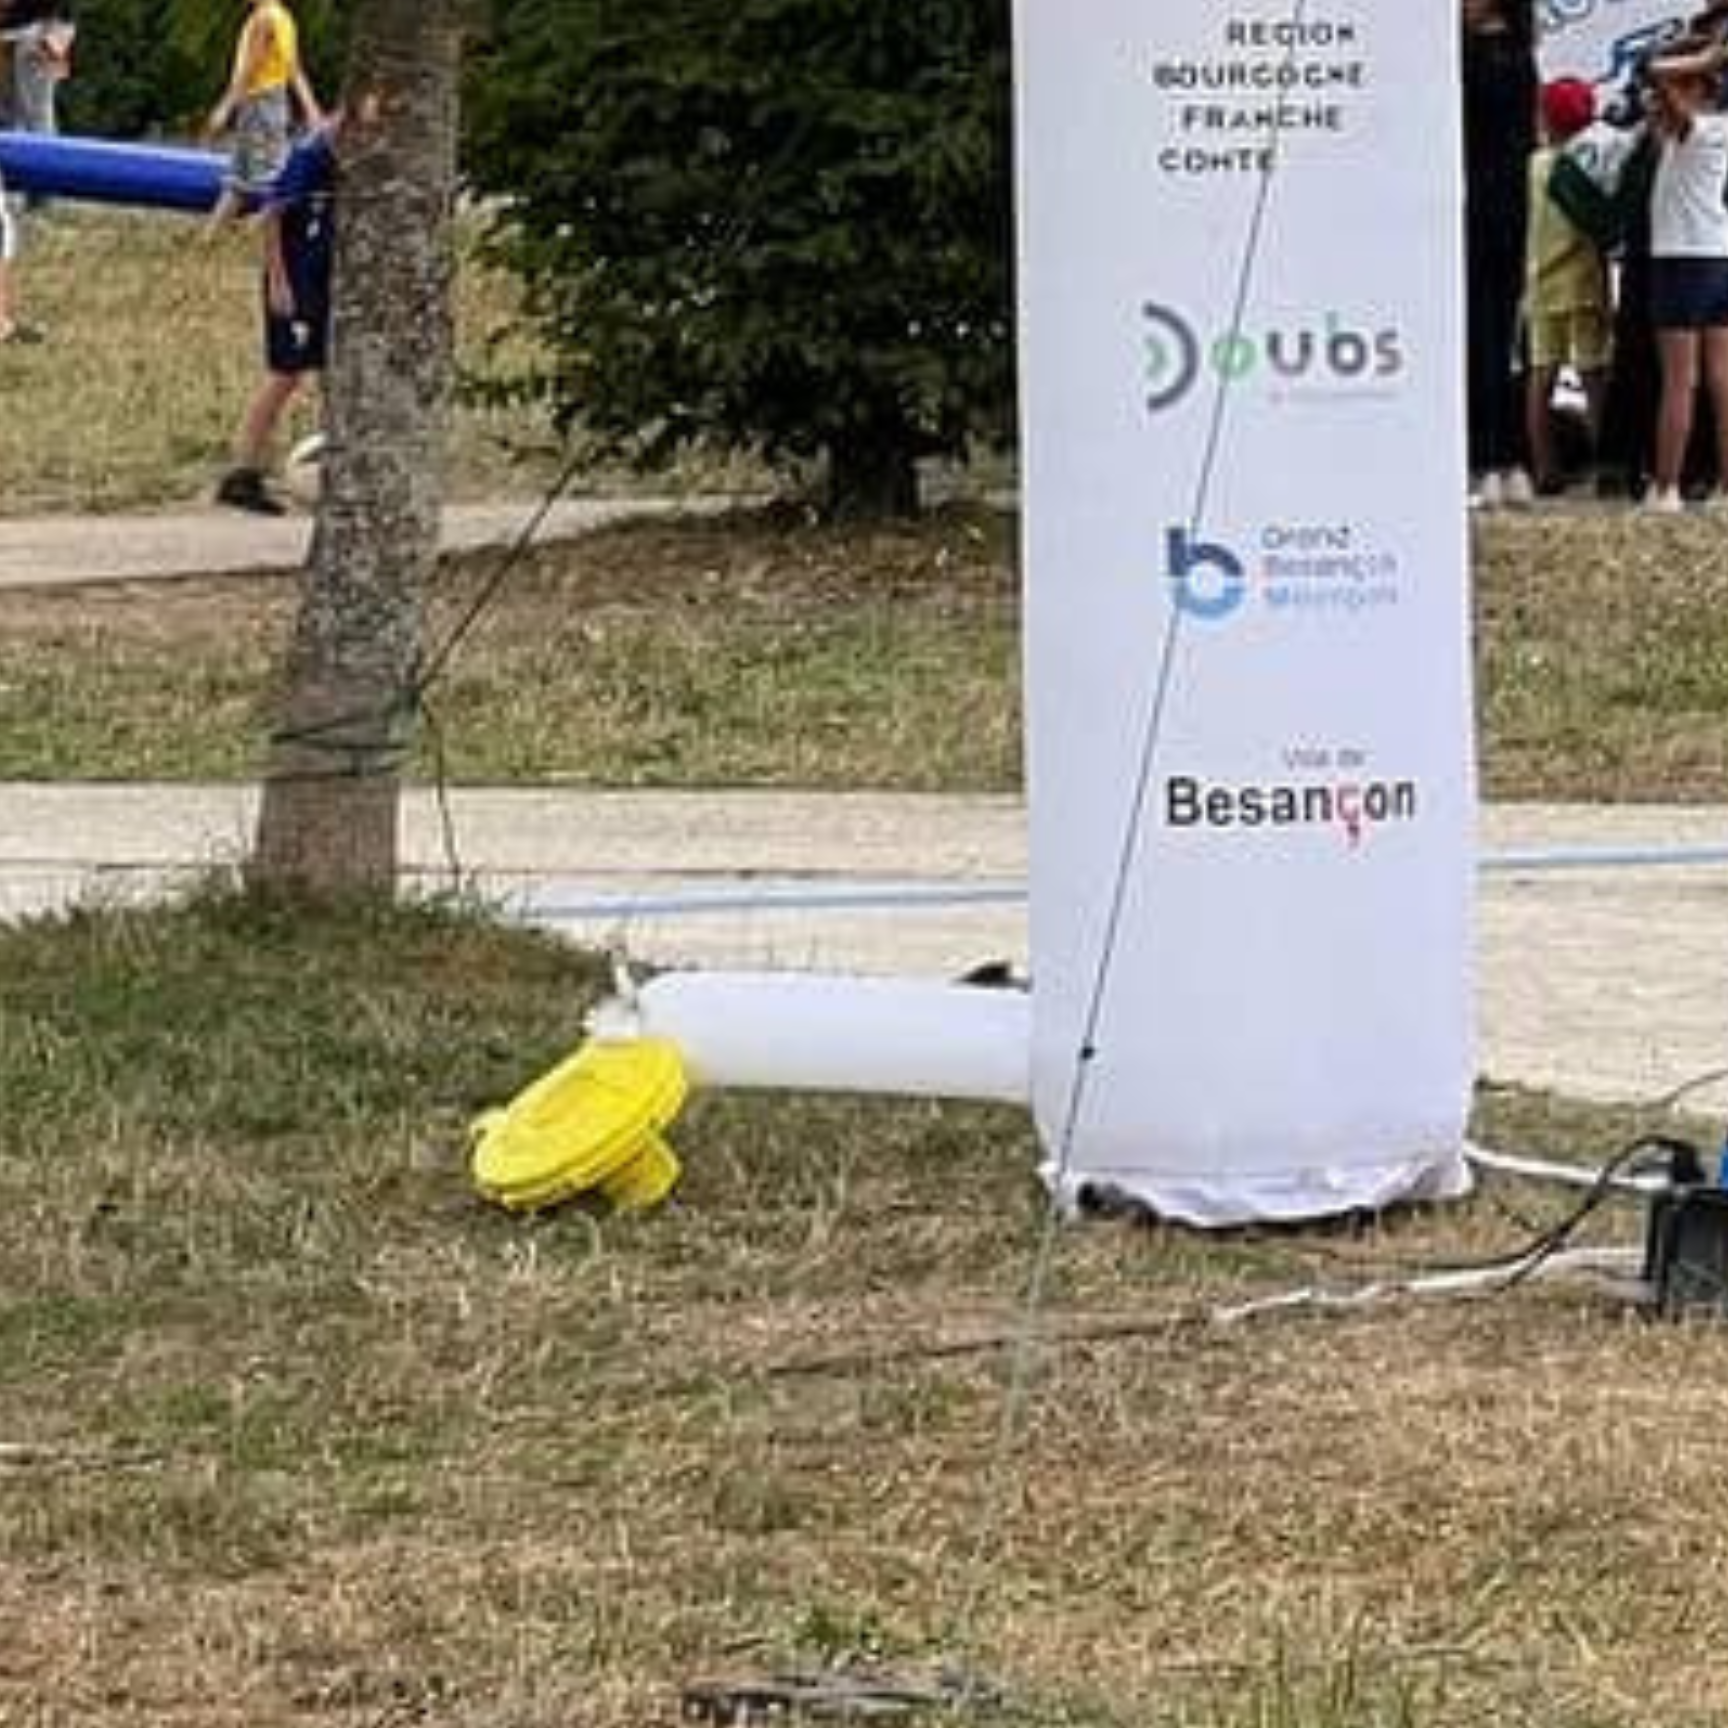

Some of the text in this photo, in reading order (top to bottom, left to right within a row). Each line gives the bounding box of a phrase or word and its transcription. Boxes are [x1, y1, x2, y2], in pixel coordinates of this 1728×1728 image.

[1152, 62, 1365, 89] BOURGOGNE
[1182, 105, 1345, 132] FRANCHE
[1164, 775, 1415, 846] Besançon
